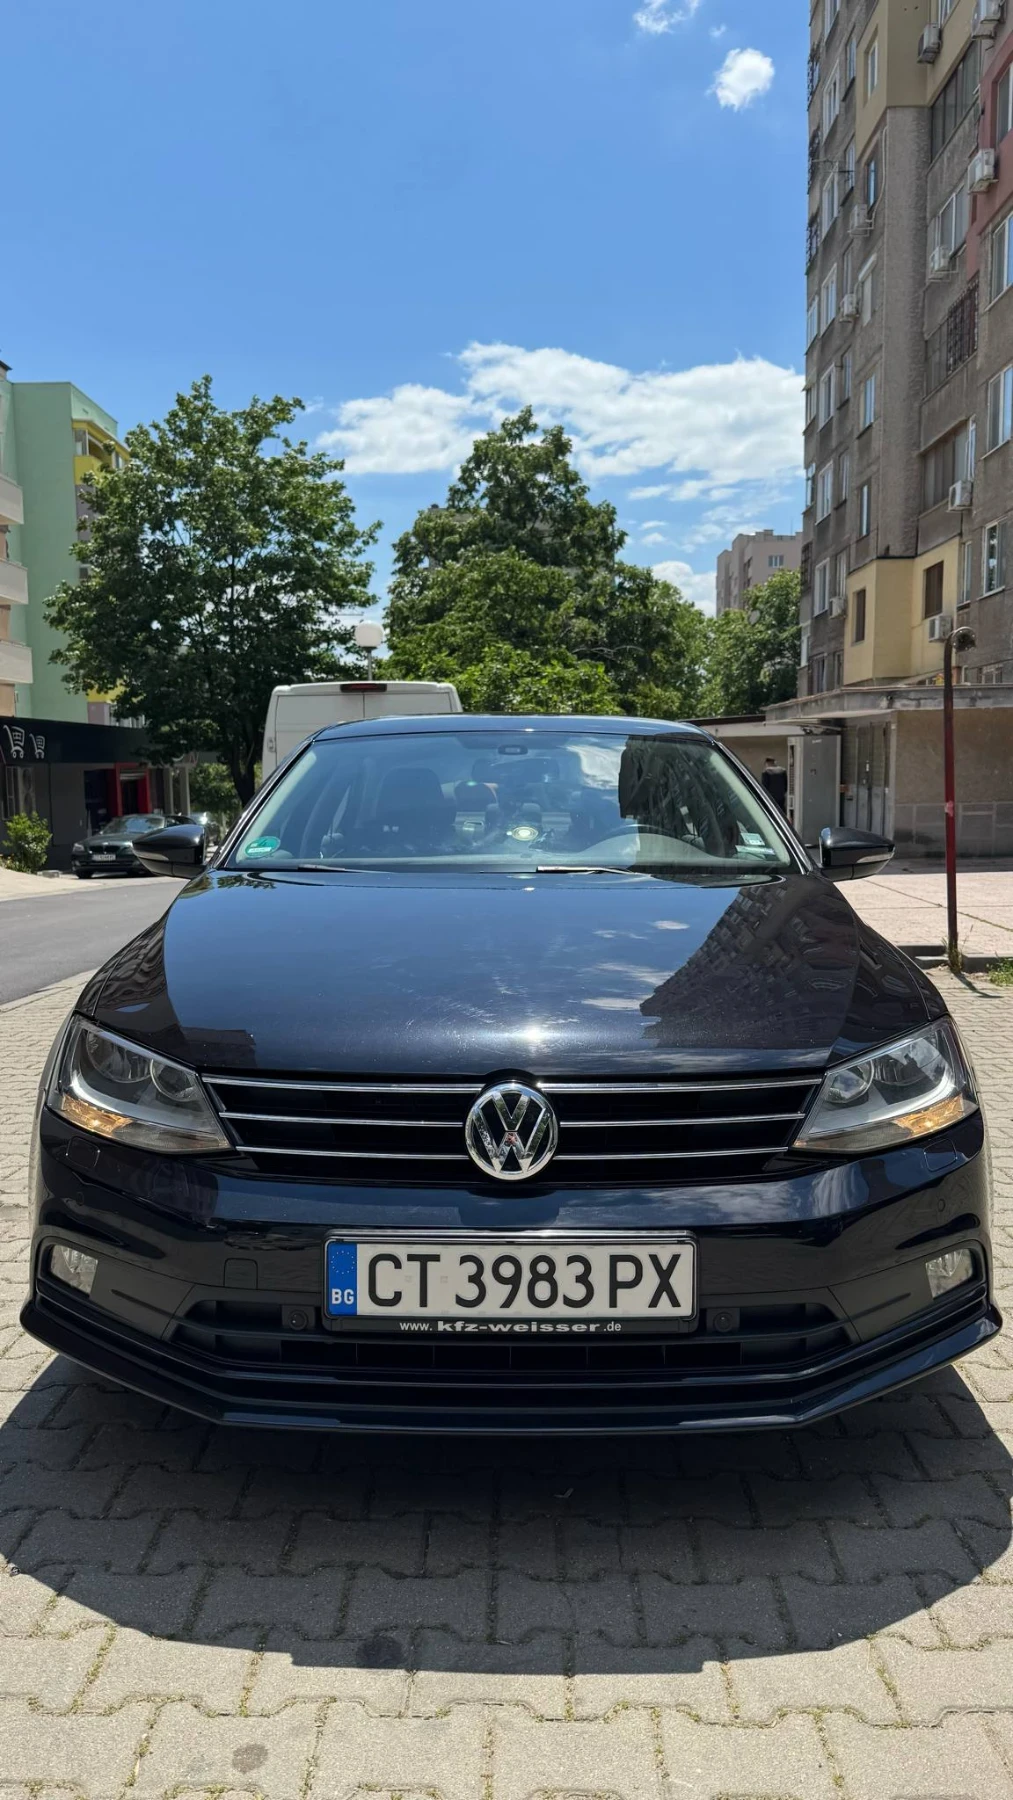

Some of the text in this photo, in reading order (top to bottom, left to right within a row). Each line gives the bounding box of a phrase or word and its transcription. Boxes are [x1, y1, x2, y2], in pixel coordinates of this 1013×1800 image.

[466, 1081, 558, 1180] VW
[331, 1288, 354, 1305] BG
[368, 1253, 682, 1308] CT 3983 PX
